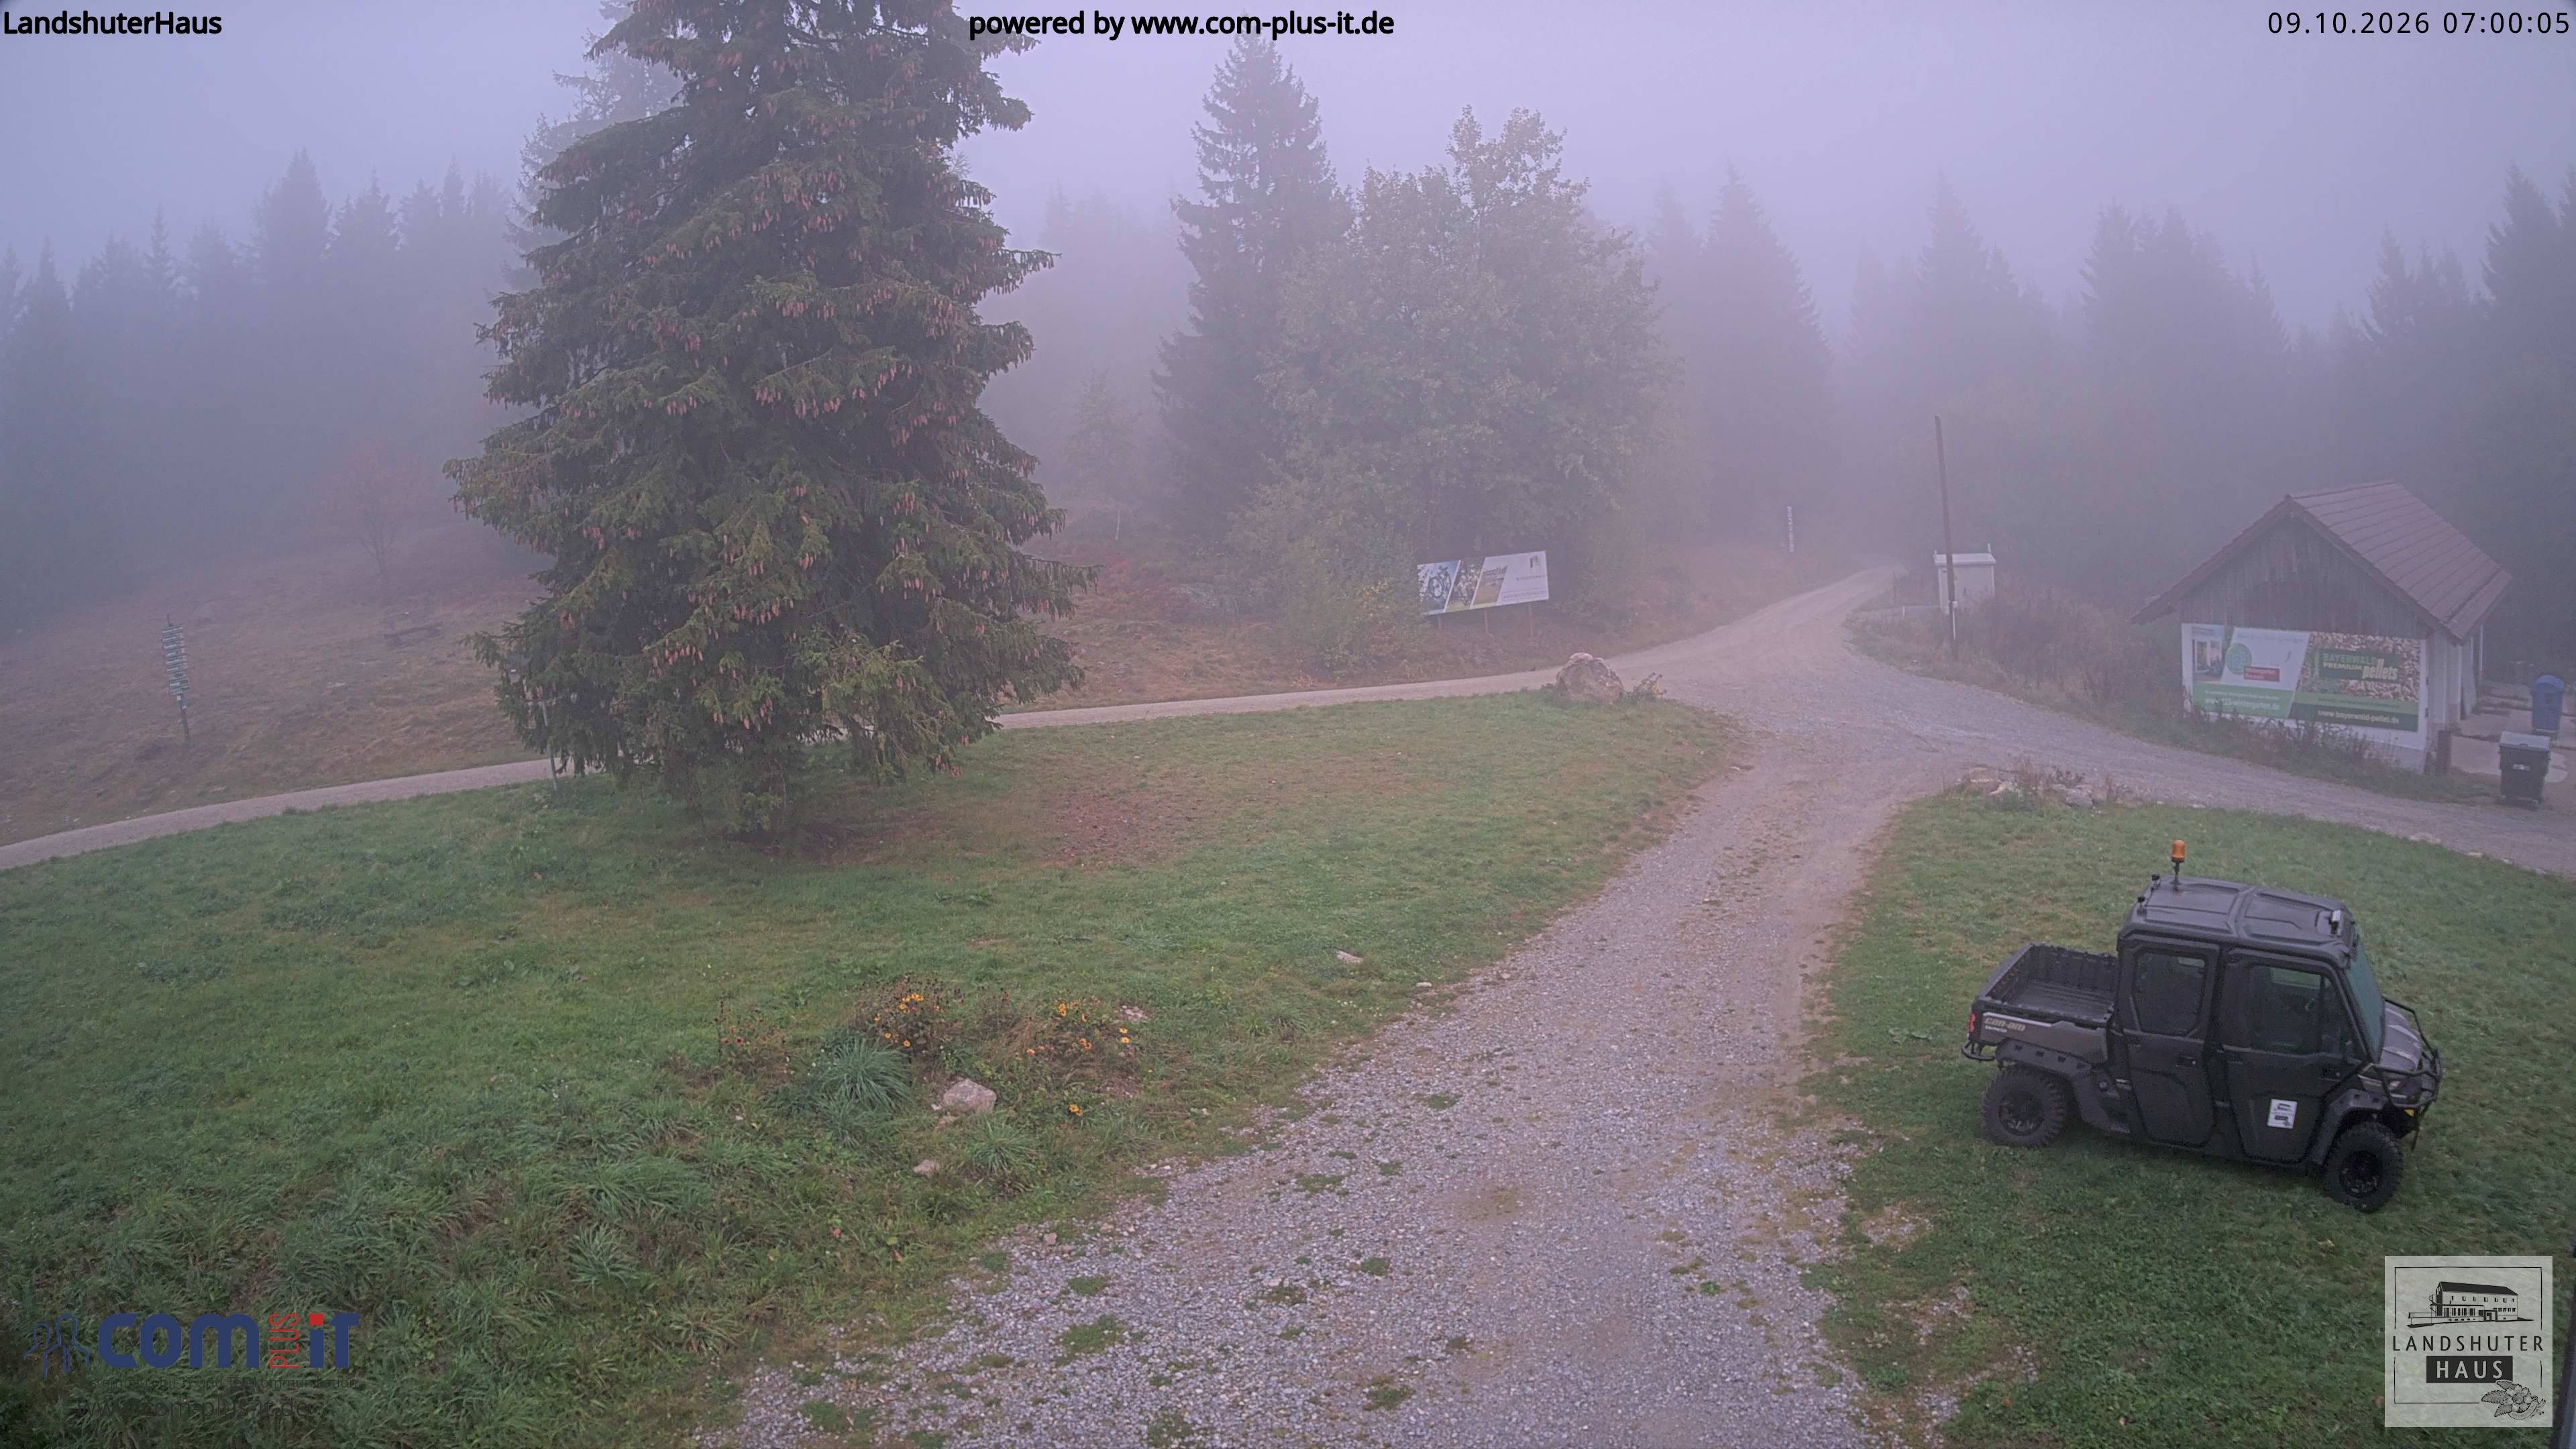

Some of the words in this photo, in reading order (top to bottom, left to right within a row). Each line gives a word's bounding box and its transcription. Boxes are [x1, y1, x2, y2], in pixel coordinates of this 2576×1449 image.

[2323, 653, 2379, 665] BAYERWALD
[2322, 661, 2363, 671] PREMIUM
[2361, 658, 2399, 680] pellets
